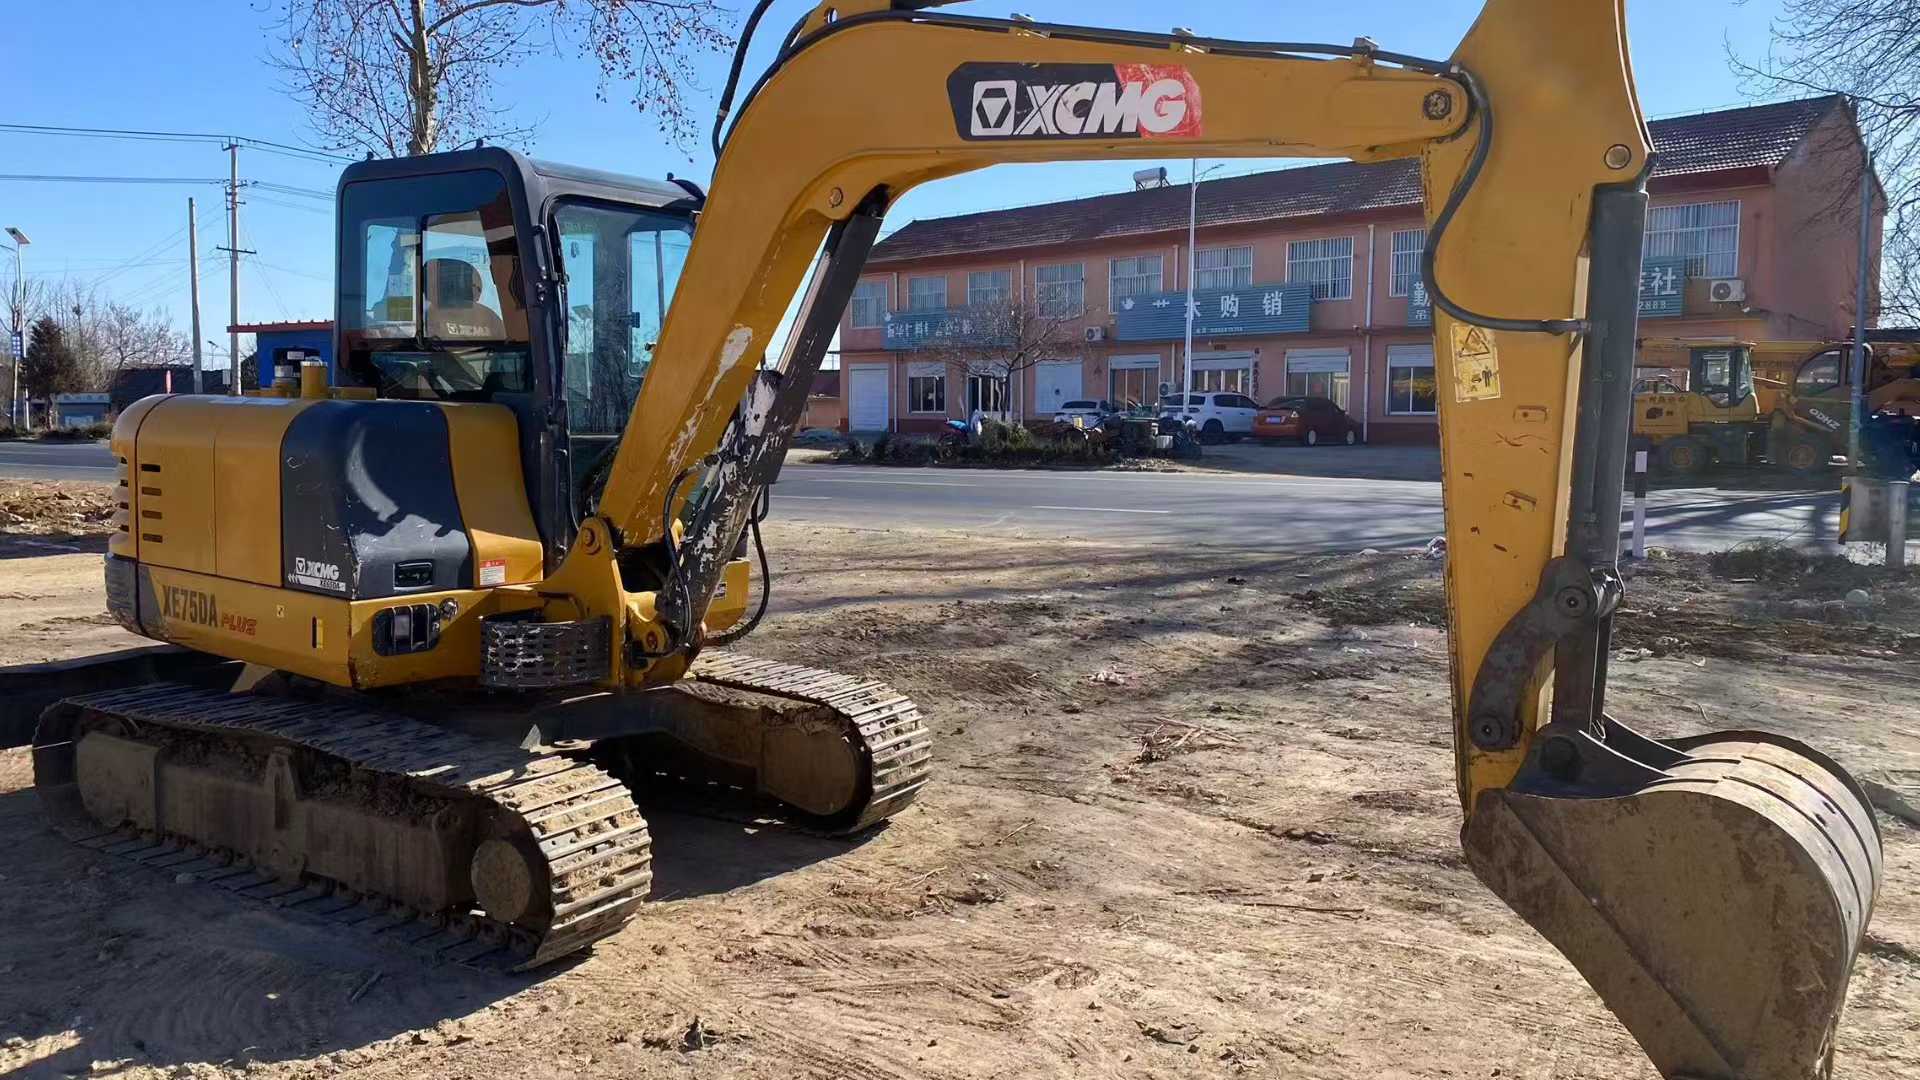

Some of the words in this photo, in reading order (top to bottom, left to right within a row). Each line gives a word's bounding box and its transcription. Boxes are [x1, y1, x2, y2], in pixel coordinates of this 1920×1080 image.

[1013, 79, 1186, 136] XCMG
[305, 560, 339, 580] XCMG
[162, 585, 218, 628] XE75DA
[222, 613, 257, 636] PLUS
